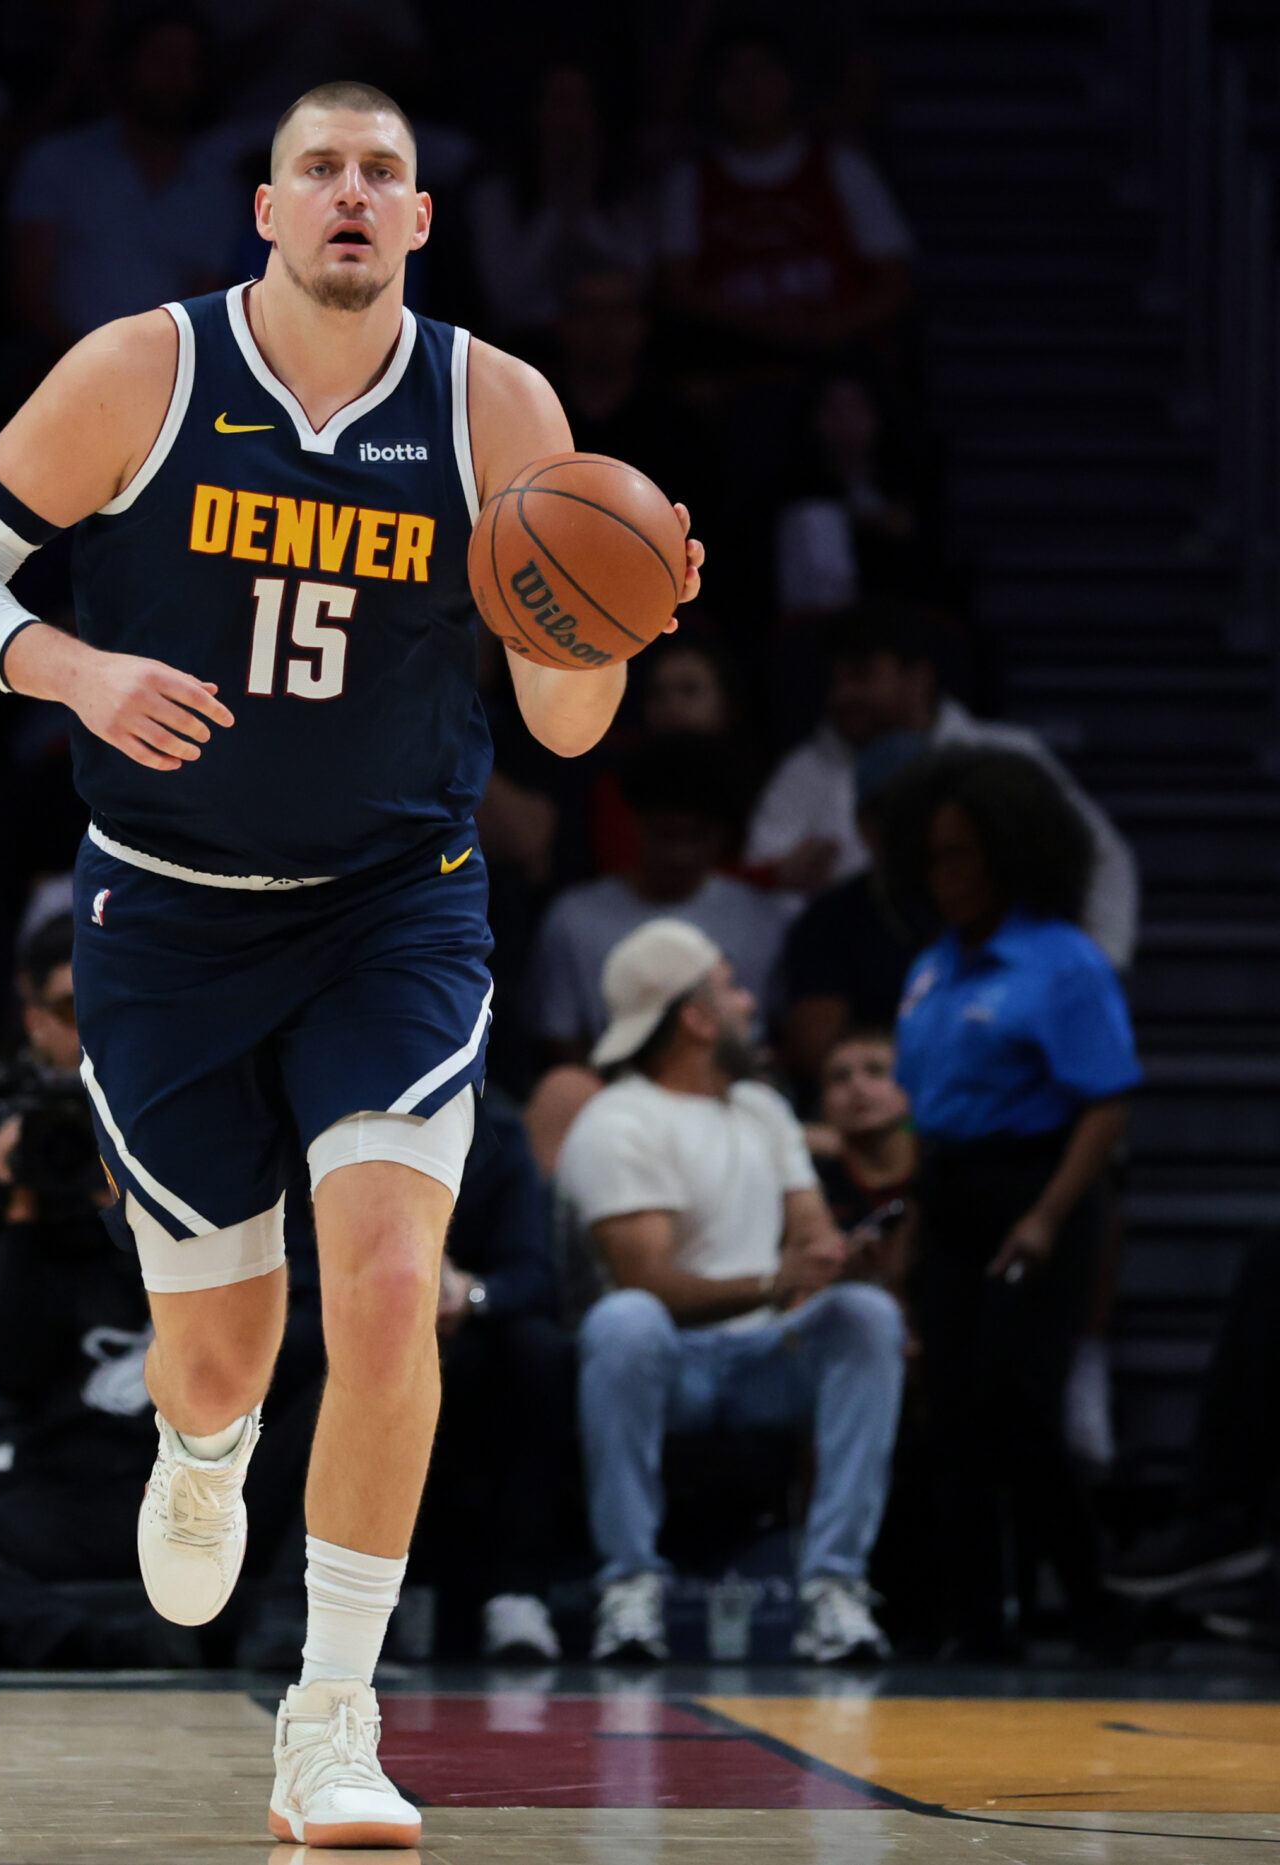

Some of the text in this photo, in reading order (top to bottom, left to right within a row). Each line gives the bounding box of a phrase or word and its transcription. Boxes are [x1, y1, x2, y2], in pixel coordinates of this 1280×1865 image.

[359, 442, 428, 462] ibotta
[189, 484, 435, 582] DENVER
[246, 576, 359, 701] 15
[510, 559, 613, 666] Wilson
